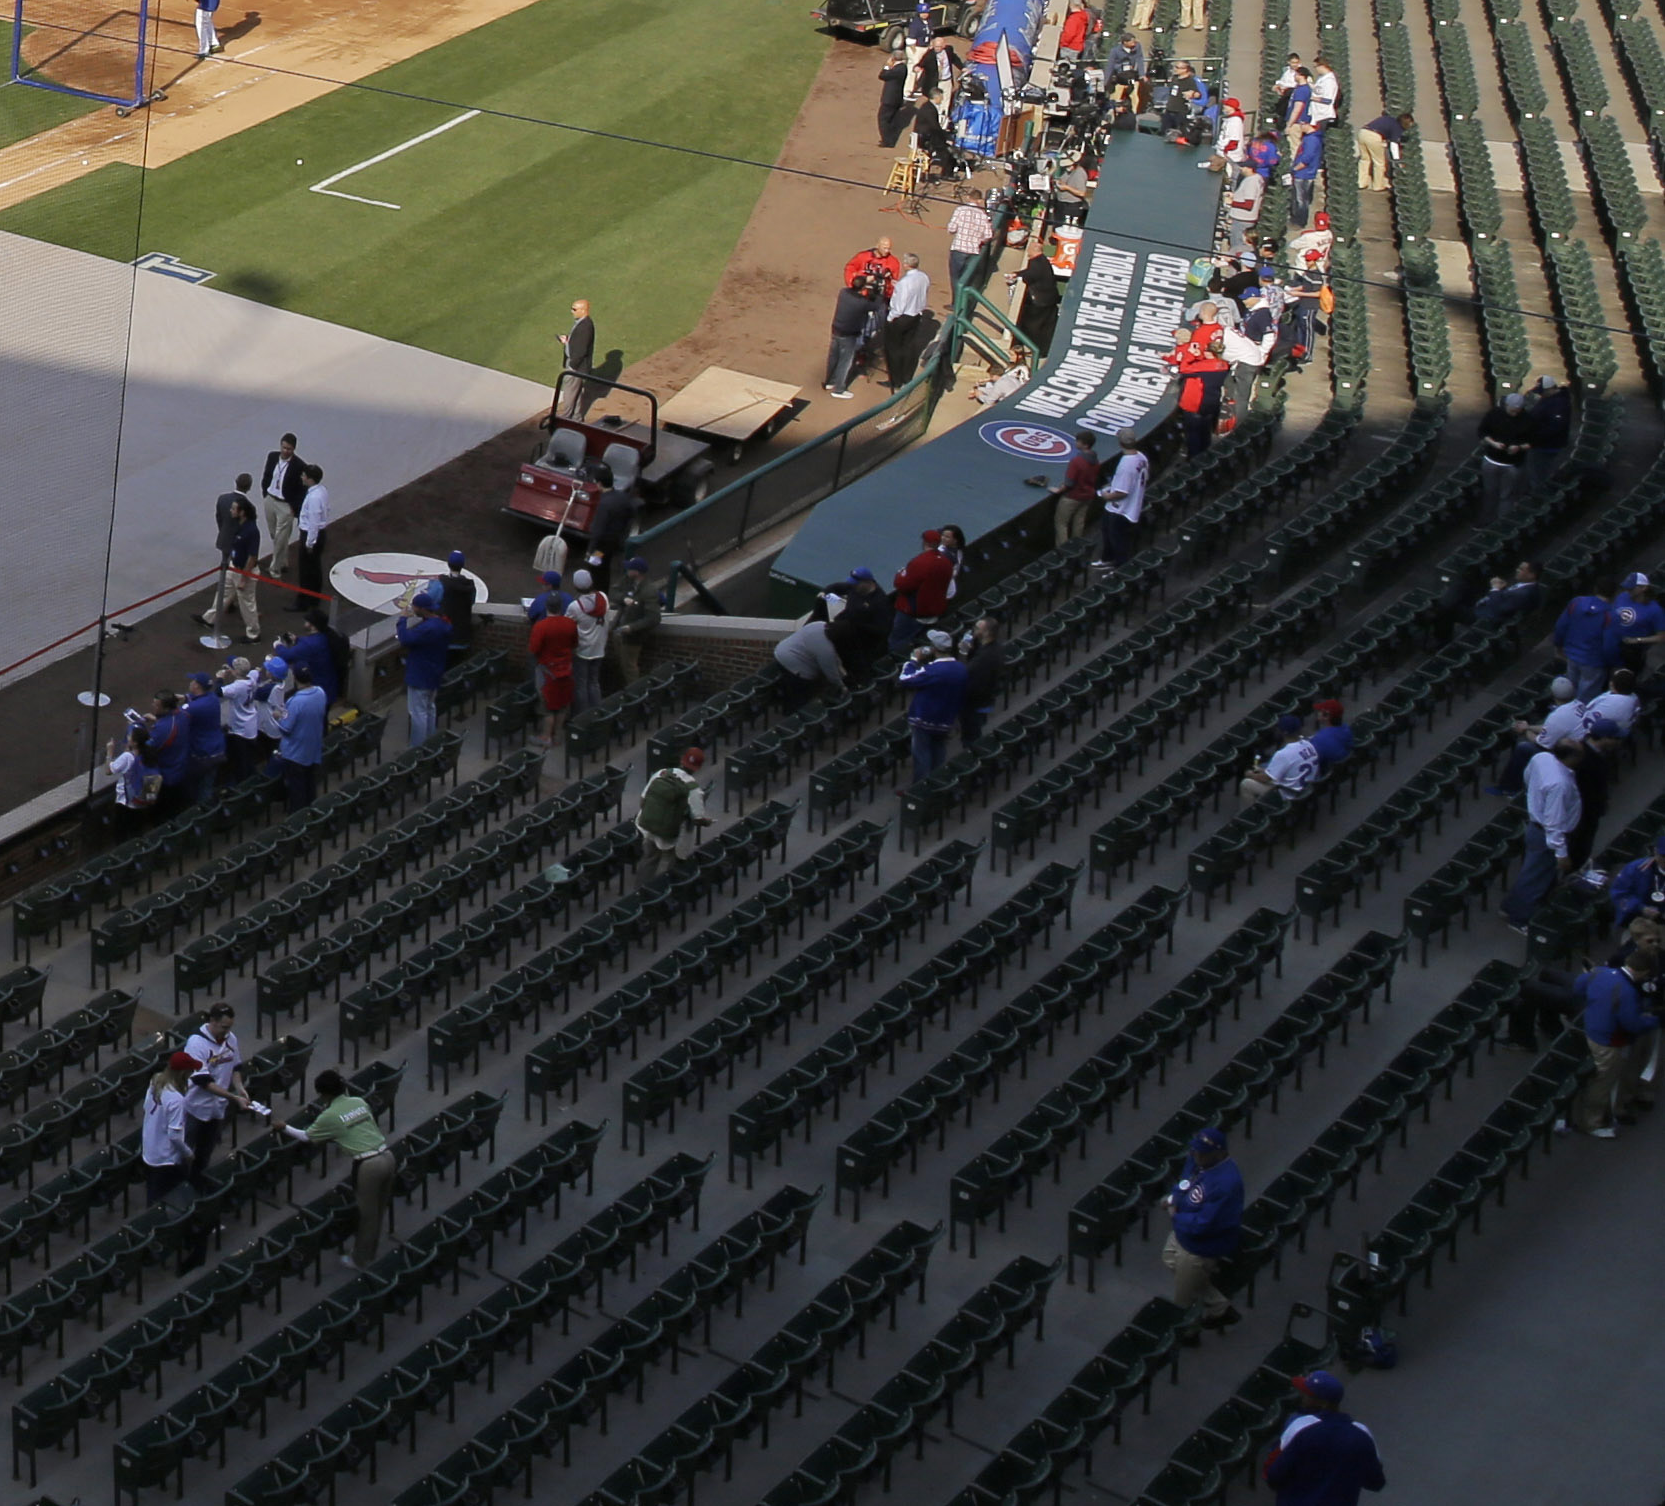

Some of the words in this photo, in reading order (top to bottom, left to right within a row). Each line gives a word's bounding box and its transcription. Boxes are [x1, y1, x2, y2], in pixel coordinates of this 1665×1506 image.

[1082, 242, 1138, 302] FRIENDLY
[1143, 252, 1191, 291] FIELD
[1071, 328, 1119, 351] TO
[1075, 300, 1127, 331] THE
[1130, 286, 1185, 348] WRIGLEY
[1126, 344, 1170, 370] OF
[1015, 348, 1115, 419] WELCOME
[1075, 366, 1171, 436] CONFINES
